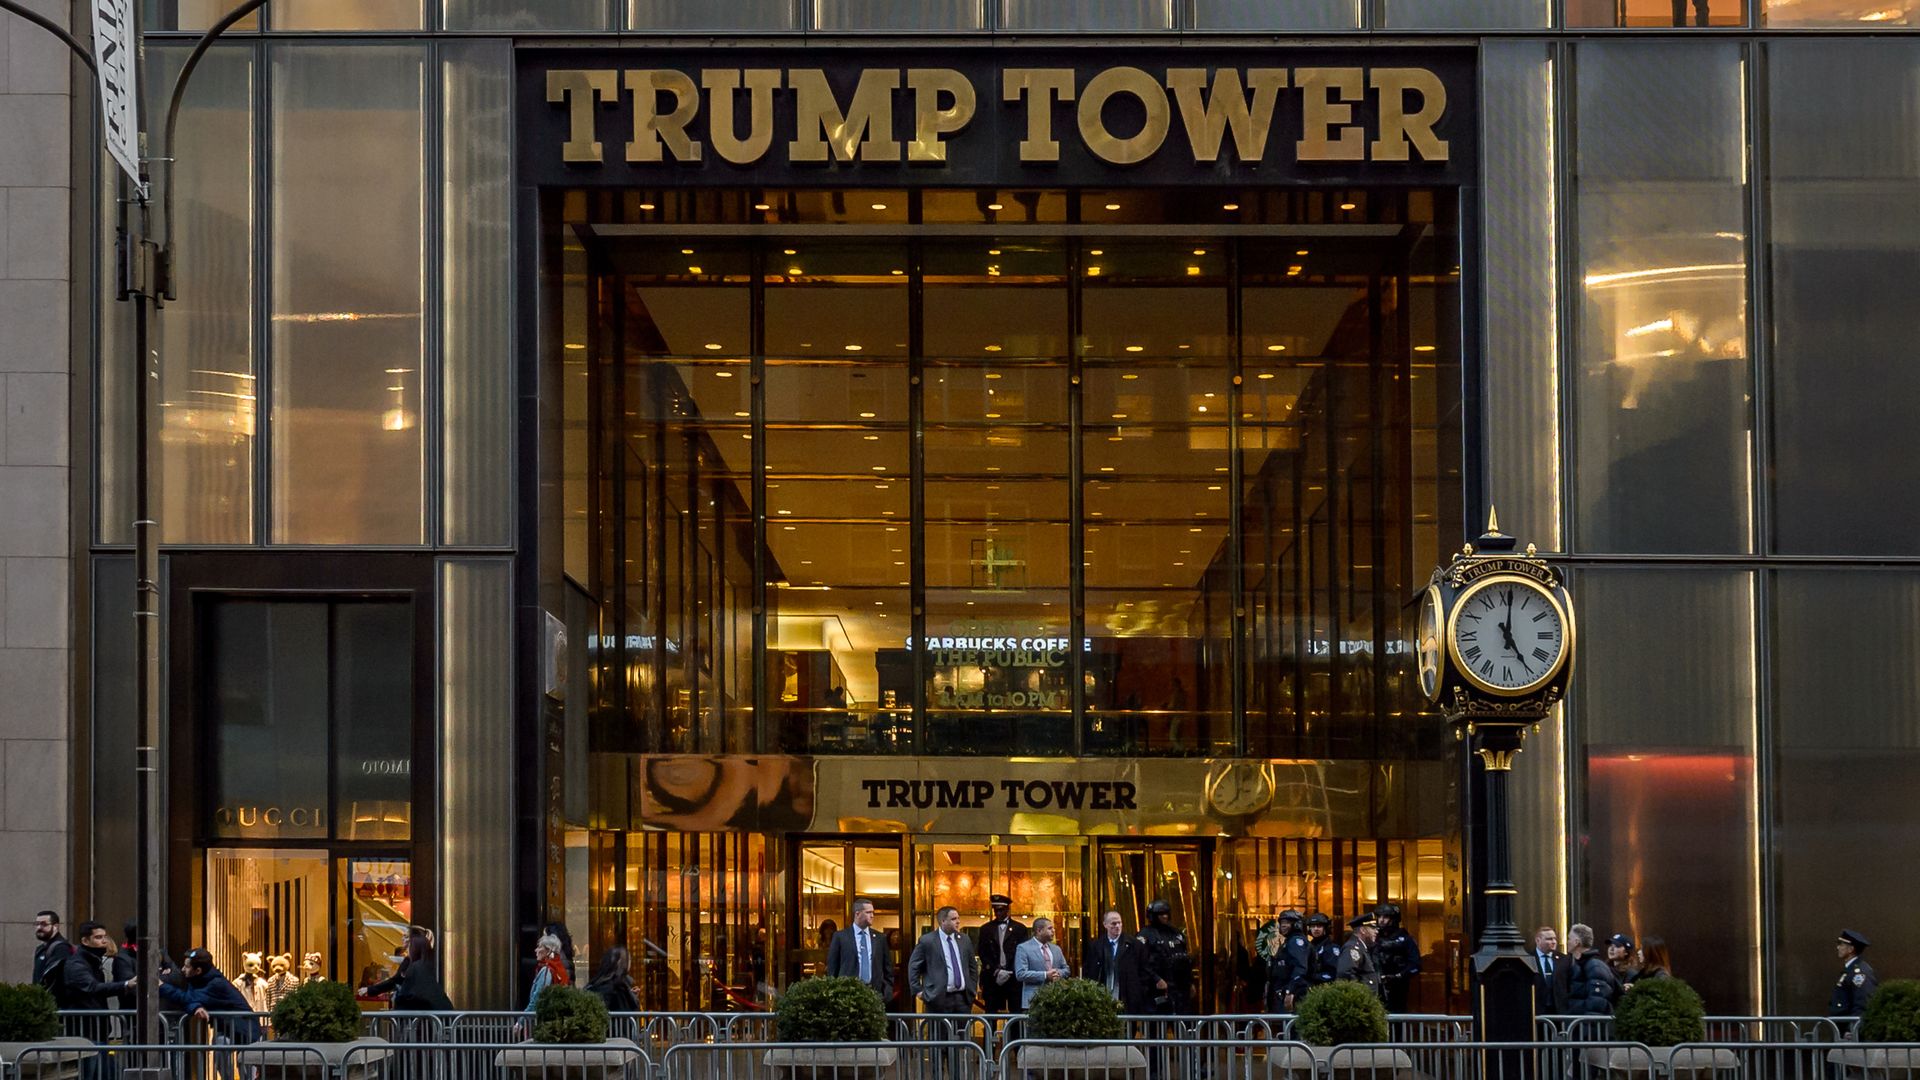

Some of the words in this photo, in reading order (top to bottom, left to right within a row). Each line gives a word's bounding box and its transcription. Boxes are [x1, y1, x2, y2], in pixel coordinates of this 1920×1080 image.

[546, 68, 977, 164] TRUMP
[1002, 66, 1449, 165] TOWER
[1466, 560, 1503, 579] TRUMP
[1507, 561, 1544, 579] TOWER
[1020, 637, 1092, 651] COFFE
[932, 650, 978, 667] THE
[983, 650, 1065, 667] PUBLIC
[862, 779, 995, 809] TRUMP
[1000, 780, 1137, 810] TOWER
